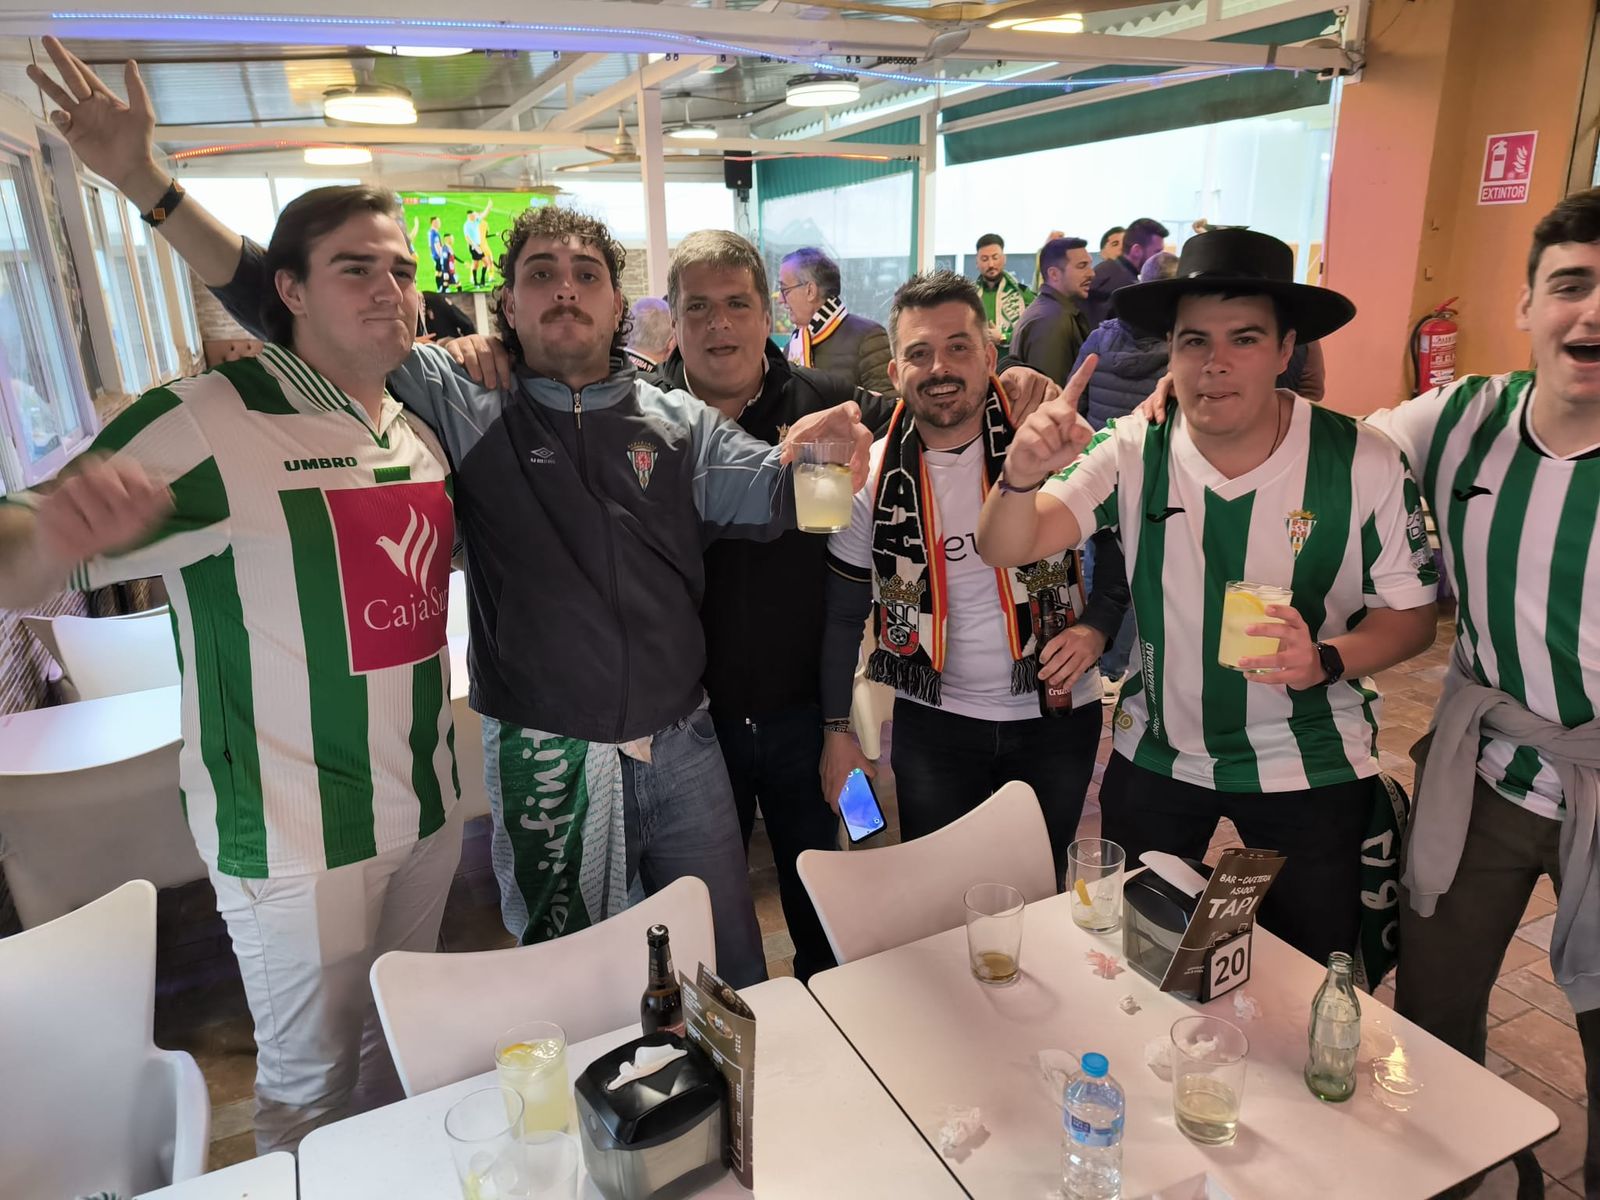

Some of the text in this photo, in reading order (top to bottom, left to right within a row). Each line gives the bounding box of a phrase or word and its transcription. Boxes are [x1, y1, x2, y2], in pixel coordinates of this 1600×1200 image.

[1481, 185, 1525, 200] EXTINTOR
[283, 456, 358, 472] UMBRO
[363, 586, 448, 632] CajaSur
[1219, 873, 1237, 884] BAR
[1214, 947, 1246, 987] 20
